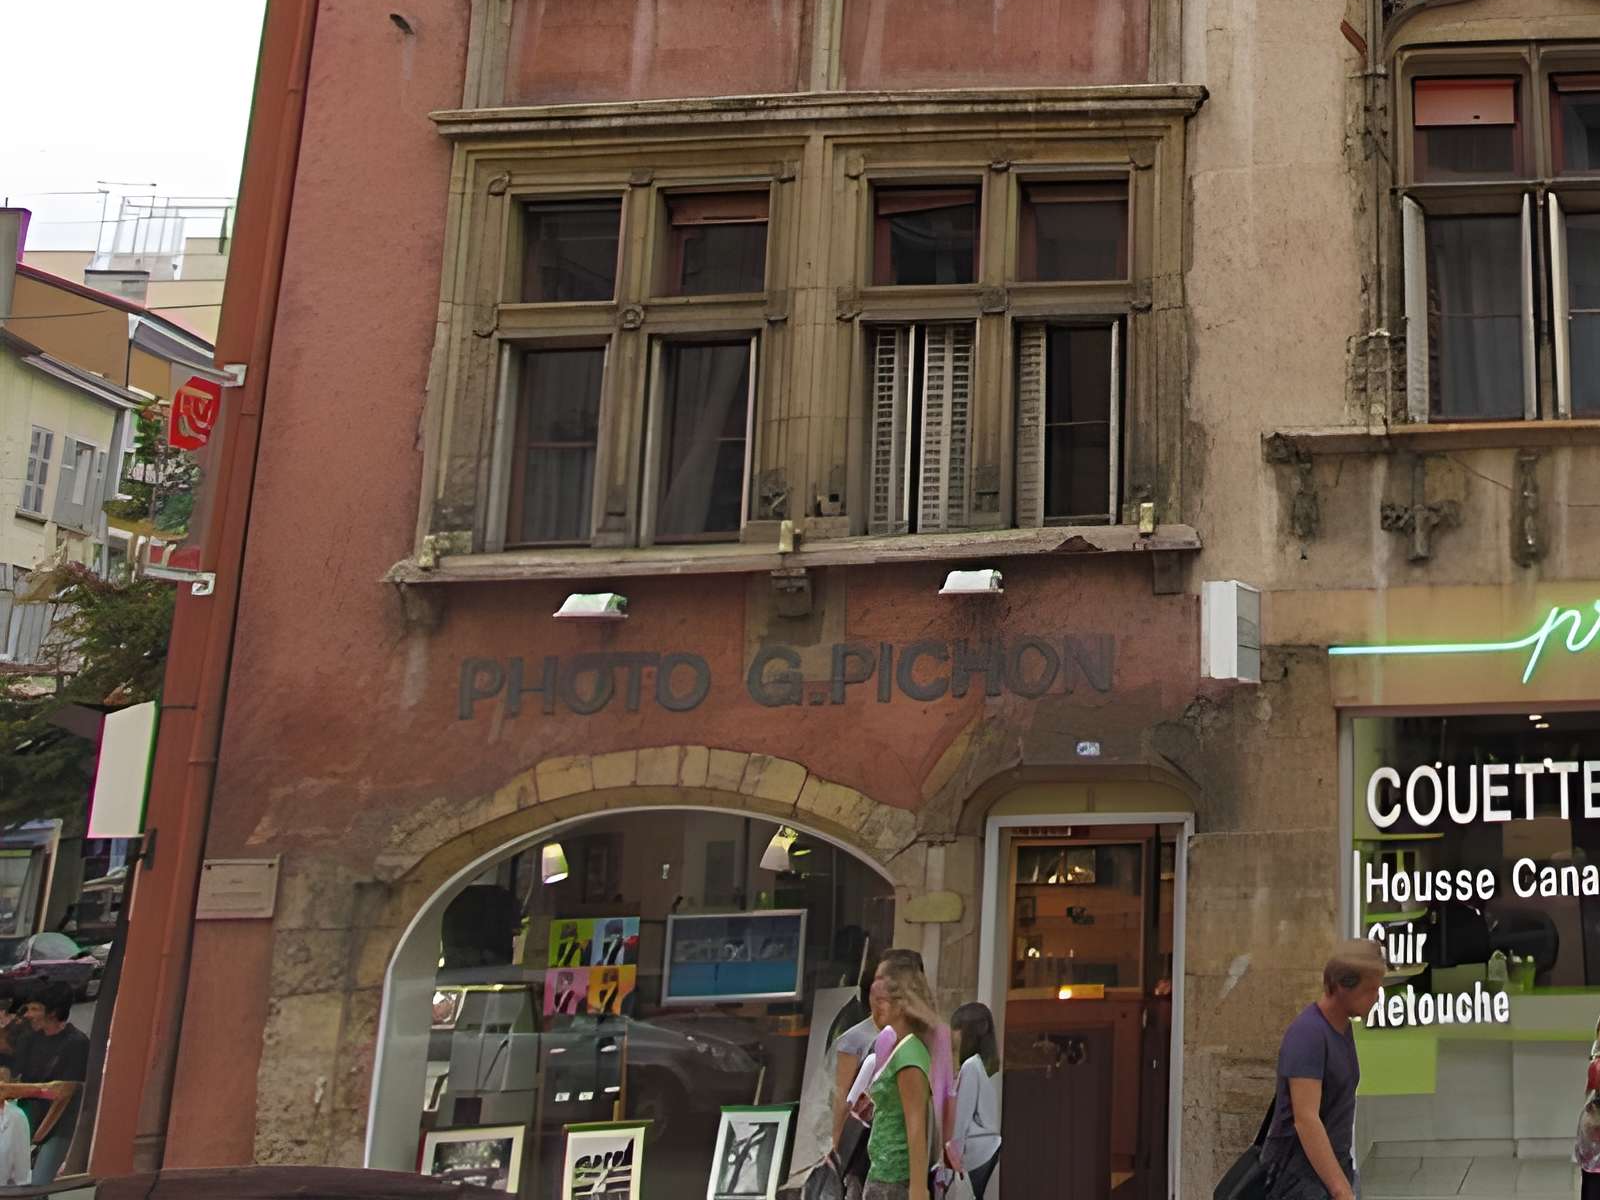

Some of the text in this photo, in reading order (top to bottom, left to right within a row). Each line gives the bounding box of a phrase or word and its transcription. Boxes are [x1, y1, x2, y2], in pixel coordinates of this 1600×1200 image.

[458, 632, 1116, 720] PHOTO G.PICHON
[1365, 862, 1496, 903] Housse
